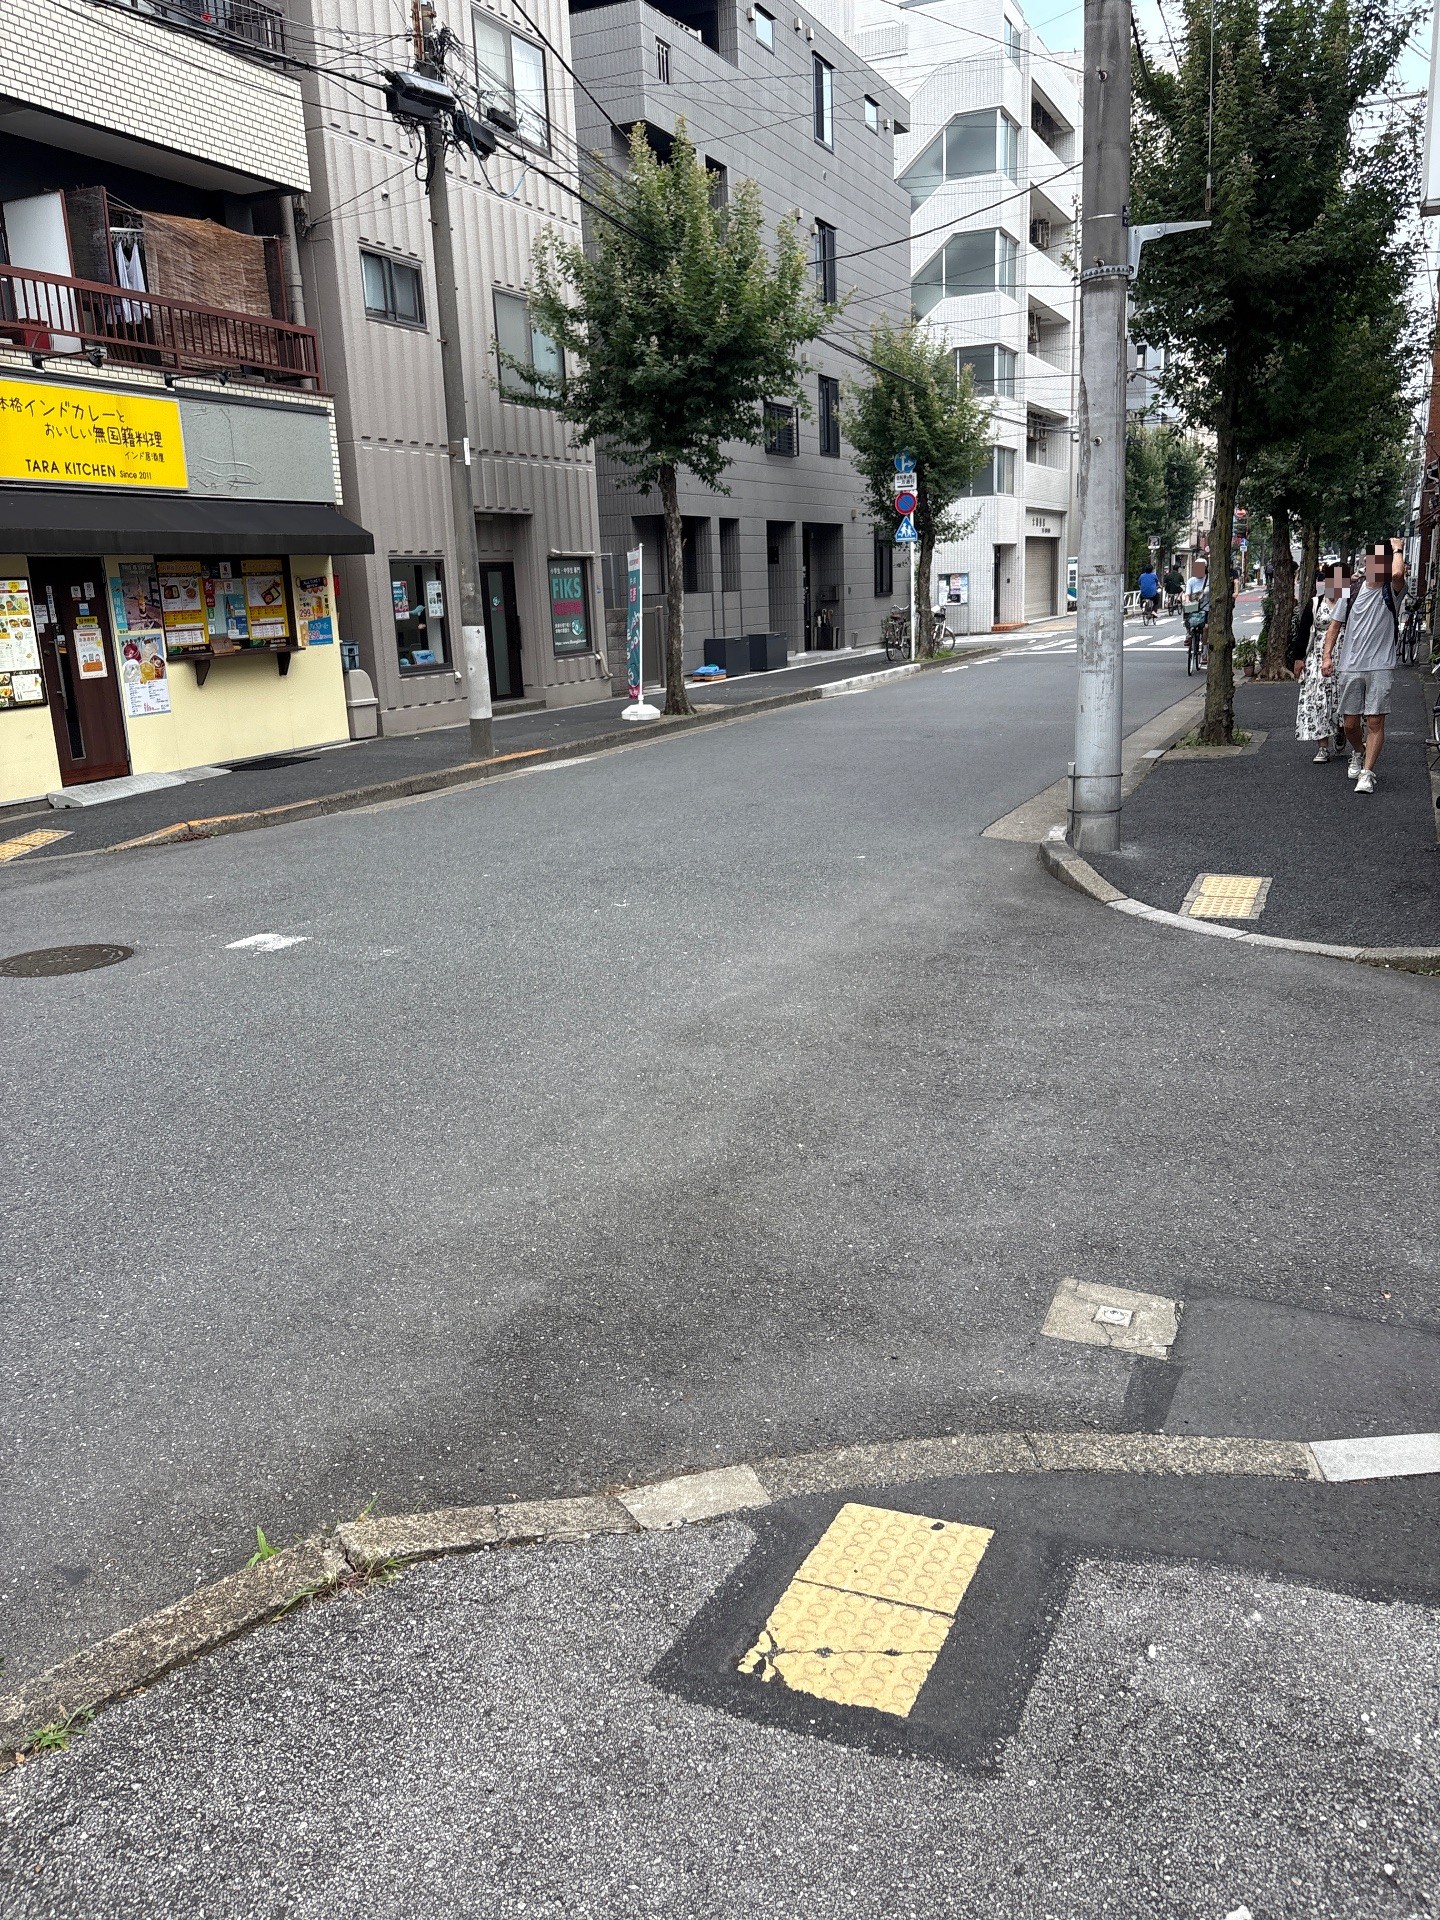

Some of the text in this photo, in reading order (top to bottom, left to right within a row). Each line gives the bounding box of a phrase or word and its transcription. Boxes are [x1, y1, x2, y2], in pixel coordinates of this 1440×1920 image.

[0, 396, 125, 423] 本格インドカレーと
[44, 422, 163, 448] おいしい無国籍料理
[125, 451, 165, 463] インド居酒屋
[25, 459, 152, 480] TARA KITCHEN Since 2011
[552, 577, 582, 599] FIKS
